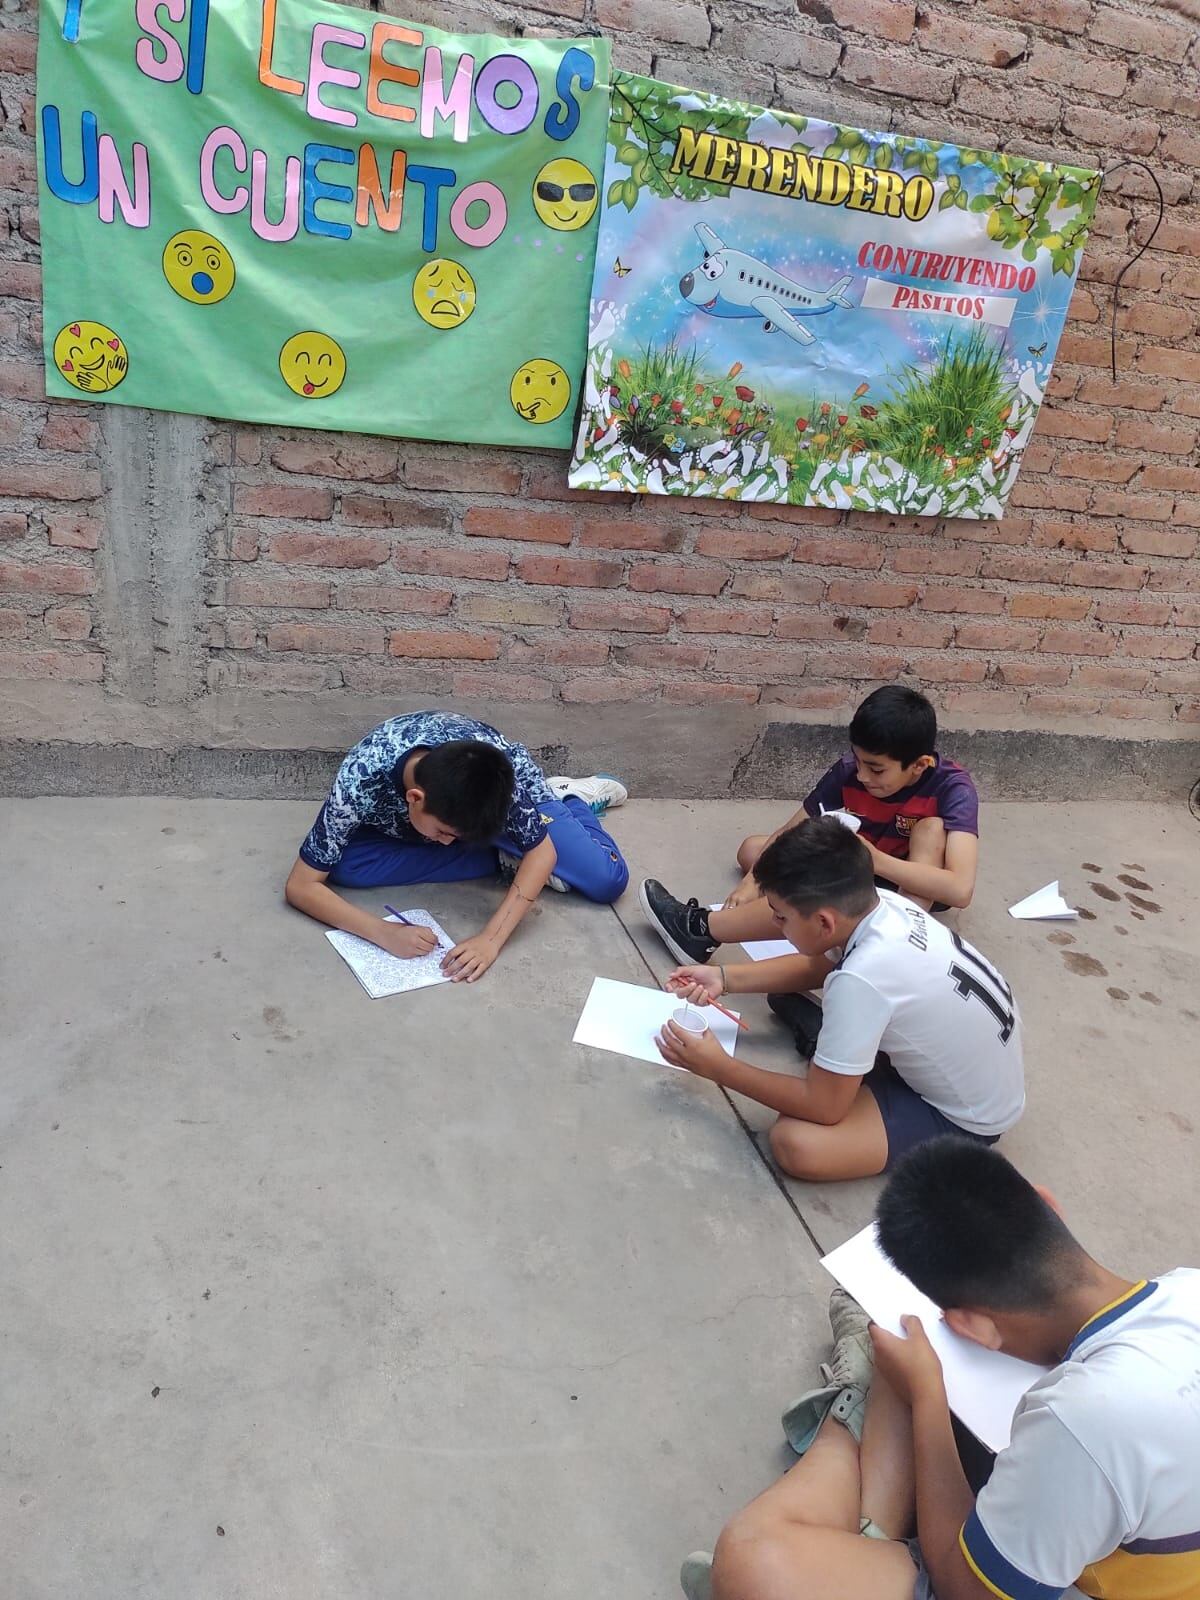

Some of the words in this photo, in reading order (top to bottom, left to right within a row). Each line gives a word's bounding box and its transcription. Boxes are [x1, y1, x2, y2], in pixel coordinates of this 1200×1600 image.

[135, 0, 209, 94] SI
[258, 0, 595, 143] LEEMOS
[42, 105, 150, 228] UN
[200, 126, 508, 252] CUENTO
[669, 126, 935, 221] MERENDERO
[857, 241, 1036, 292] CONTRUYENDO
[891, 286, 985, 320] PASITOS
